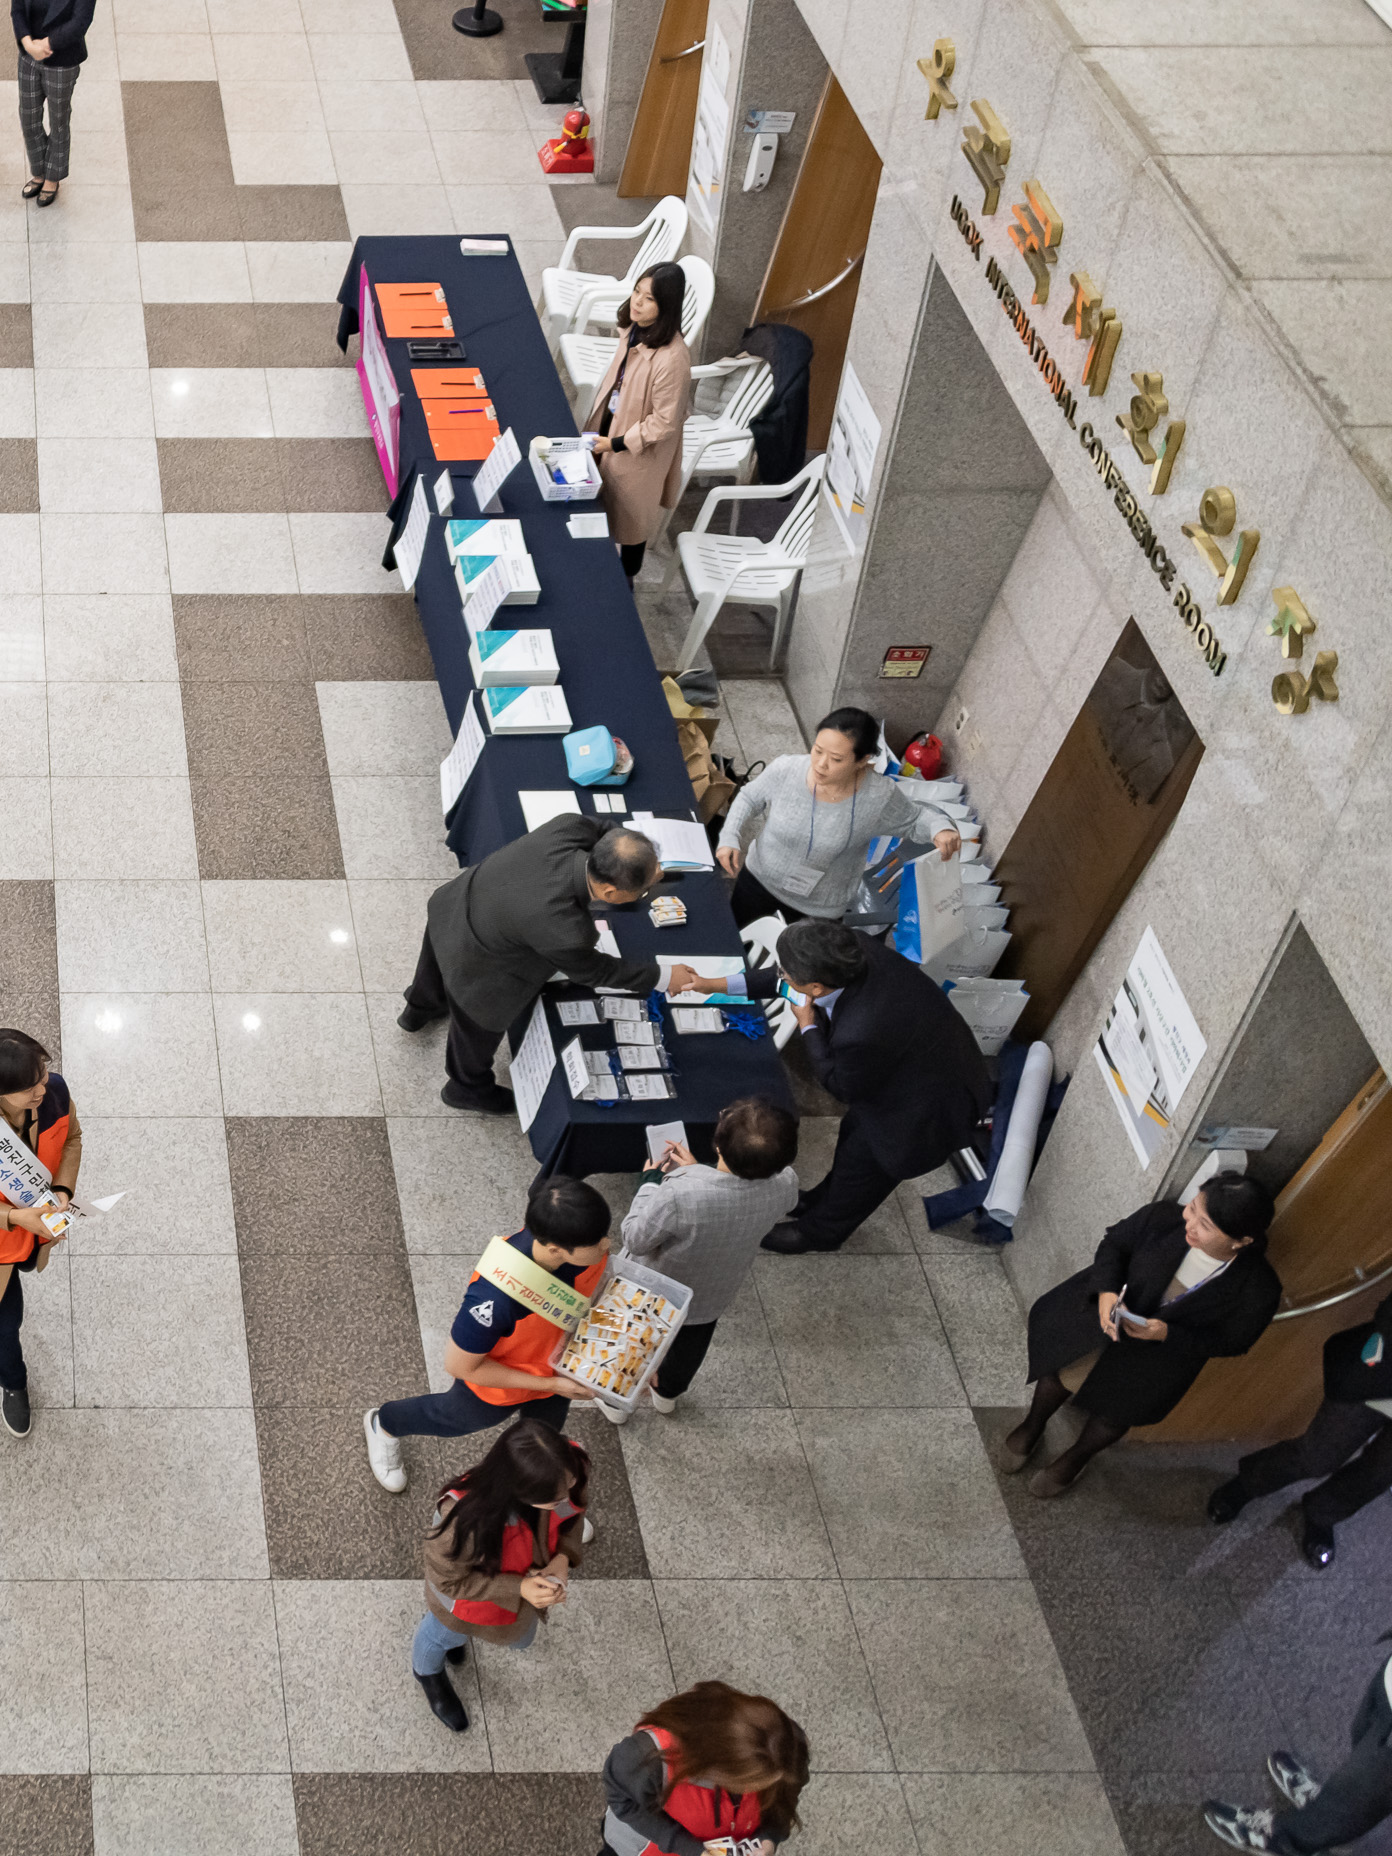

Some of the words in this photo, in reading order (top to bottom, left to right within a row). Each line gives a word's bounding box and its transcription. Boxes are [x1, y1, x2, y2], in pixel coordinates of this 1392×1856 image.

[985, 257, 1077, 429] INTERNATIONAL
[1080, 422, 1177, 591] CONFERENCE
[1173, 583, 1227, 677] ROOM
[892, 650, 925, 659] 소화기
[491, 1266, 564, 1320] 조기검진으로
